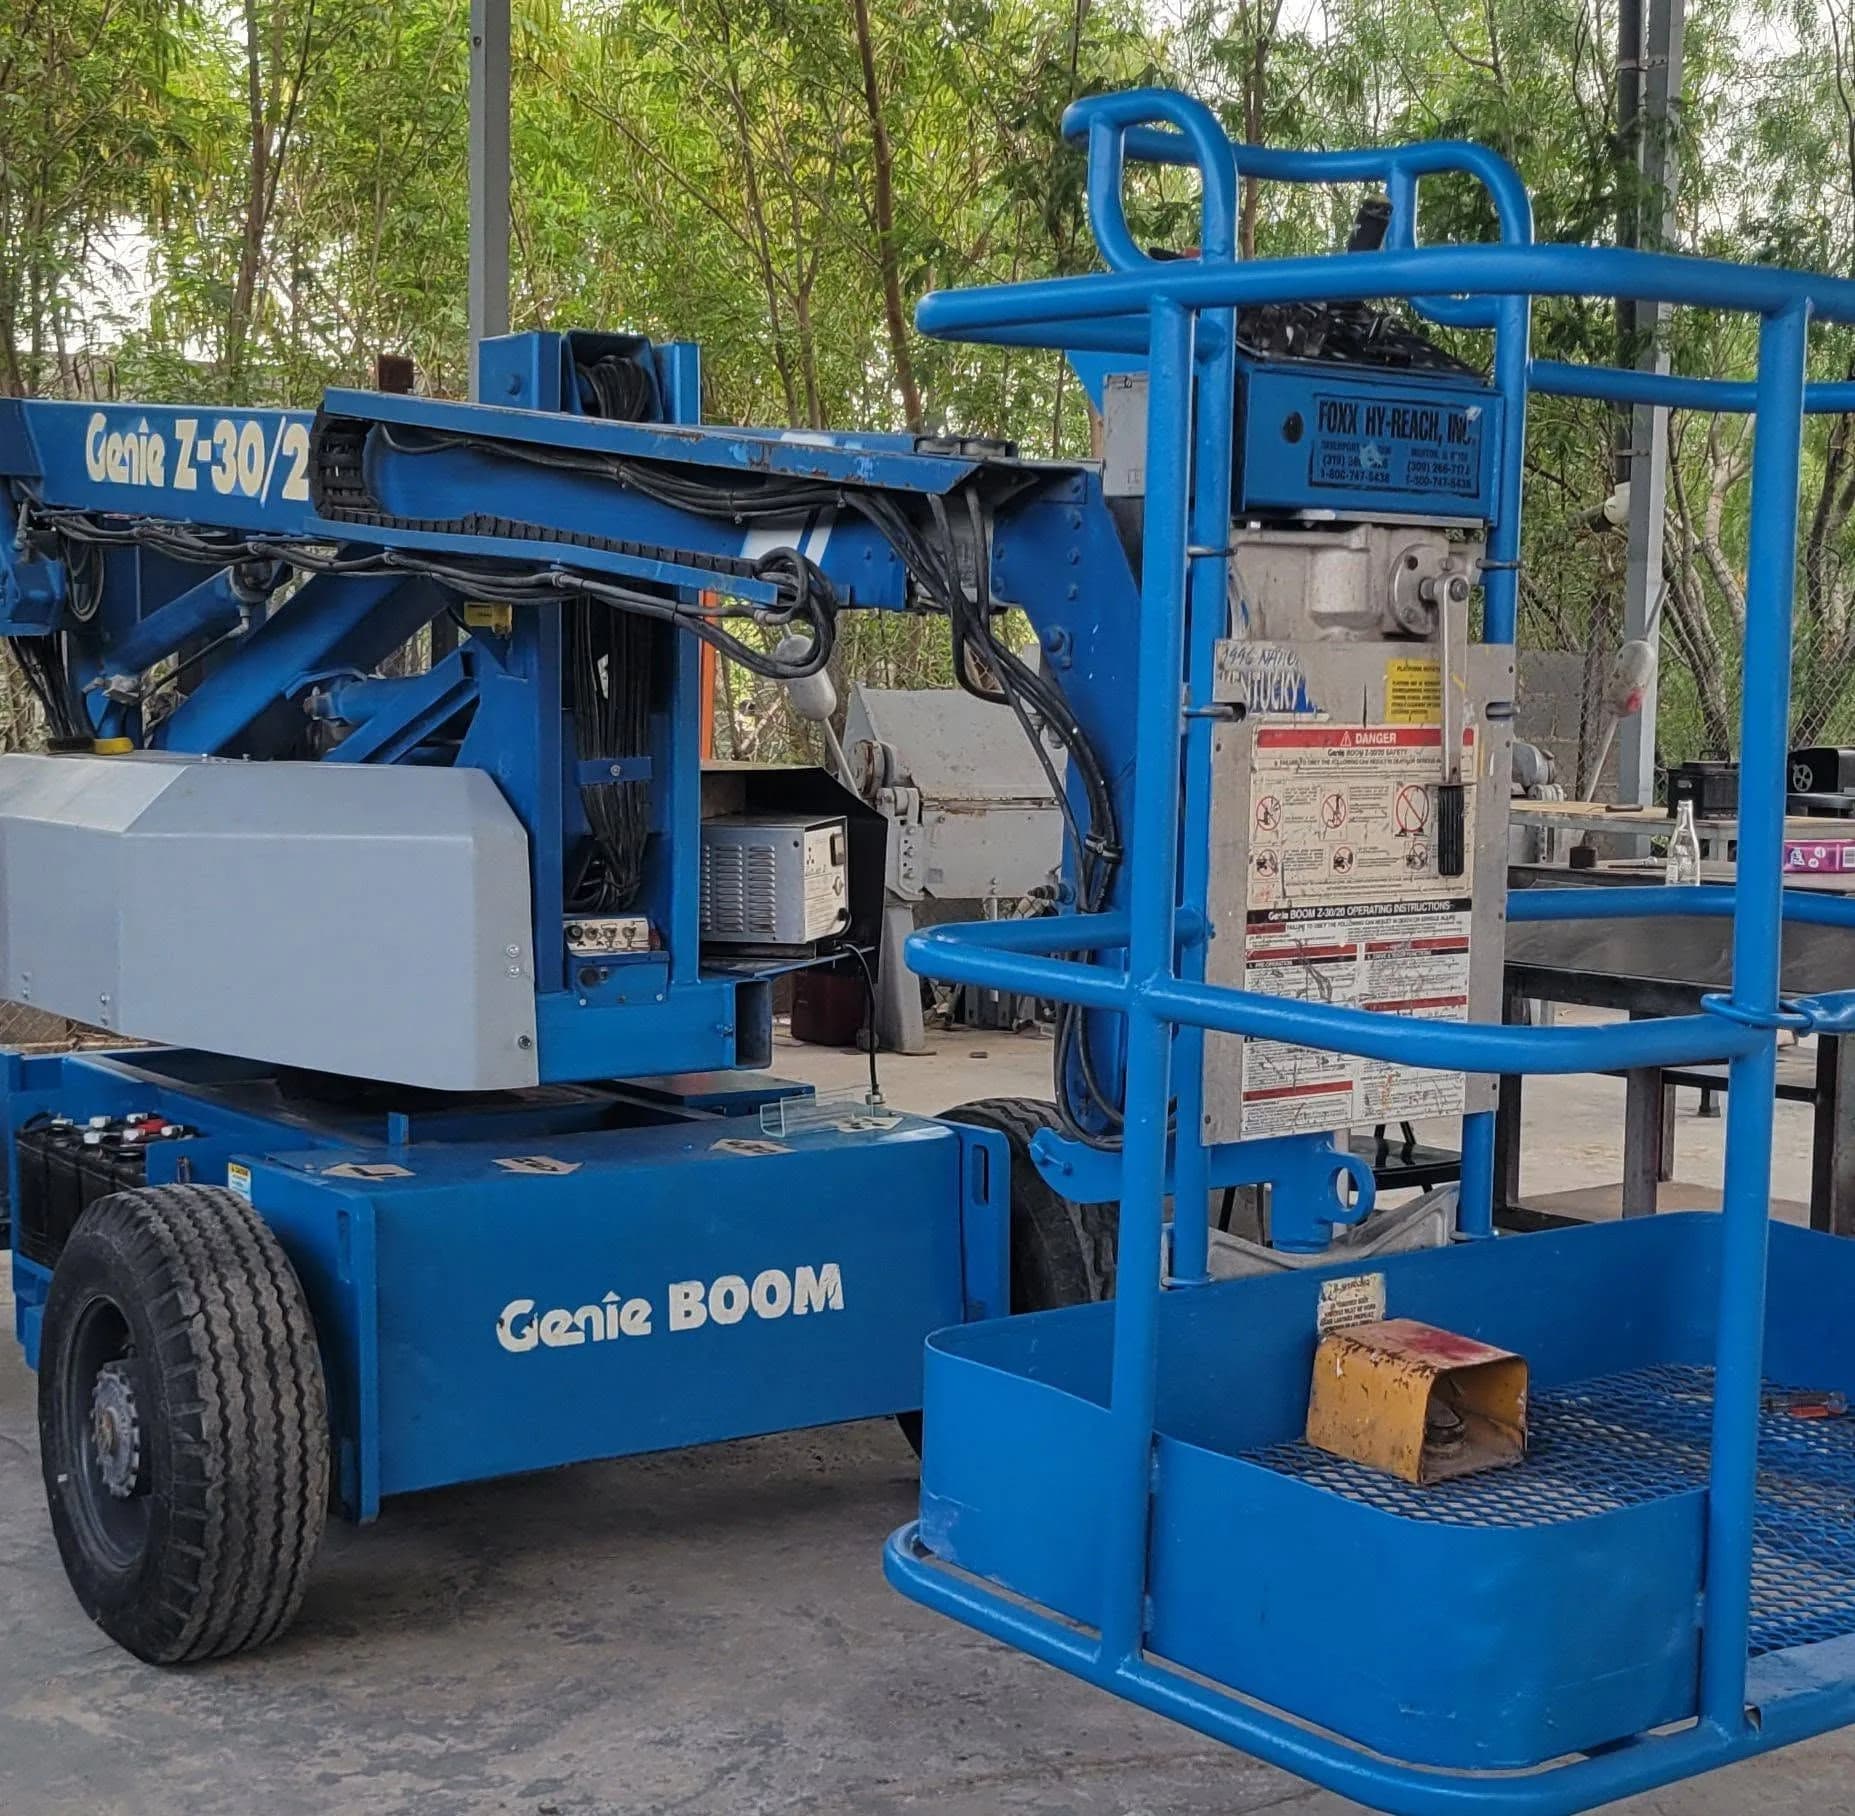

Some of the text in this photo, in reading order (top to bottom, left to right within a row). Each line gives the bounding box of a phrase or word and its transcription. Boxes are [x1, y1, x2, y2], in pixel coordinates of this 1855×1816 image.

[1318, 400, 1359, 434] FOXX
[1365, 405, 1442, 447] HY-REACH,
[1355, 732, 1397, 745] DANGER
[1290, 908, 1315, 919] BOOM
[1346, 903, 1392, 916] OPERATING
[1393, 901, 1450, 914] INSTRUCTIONS
[669, 1263, 844, 1332] BOOM
